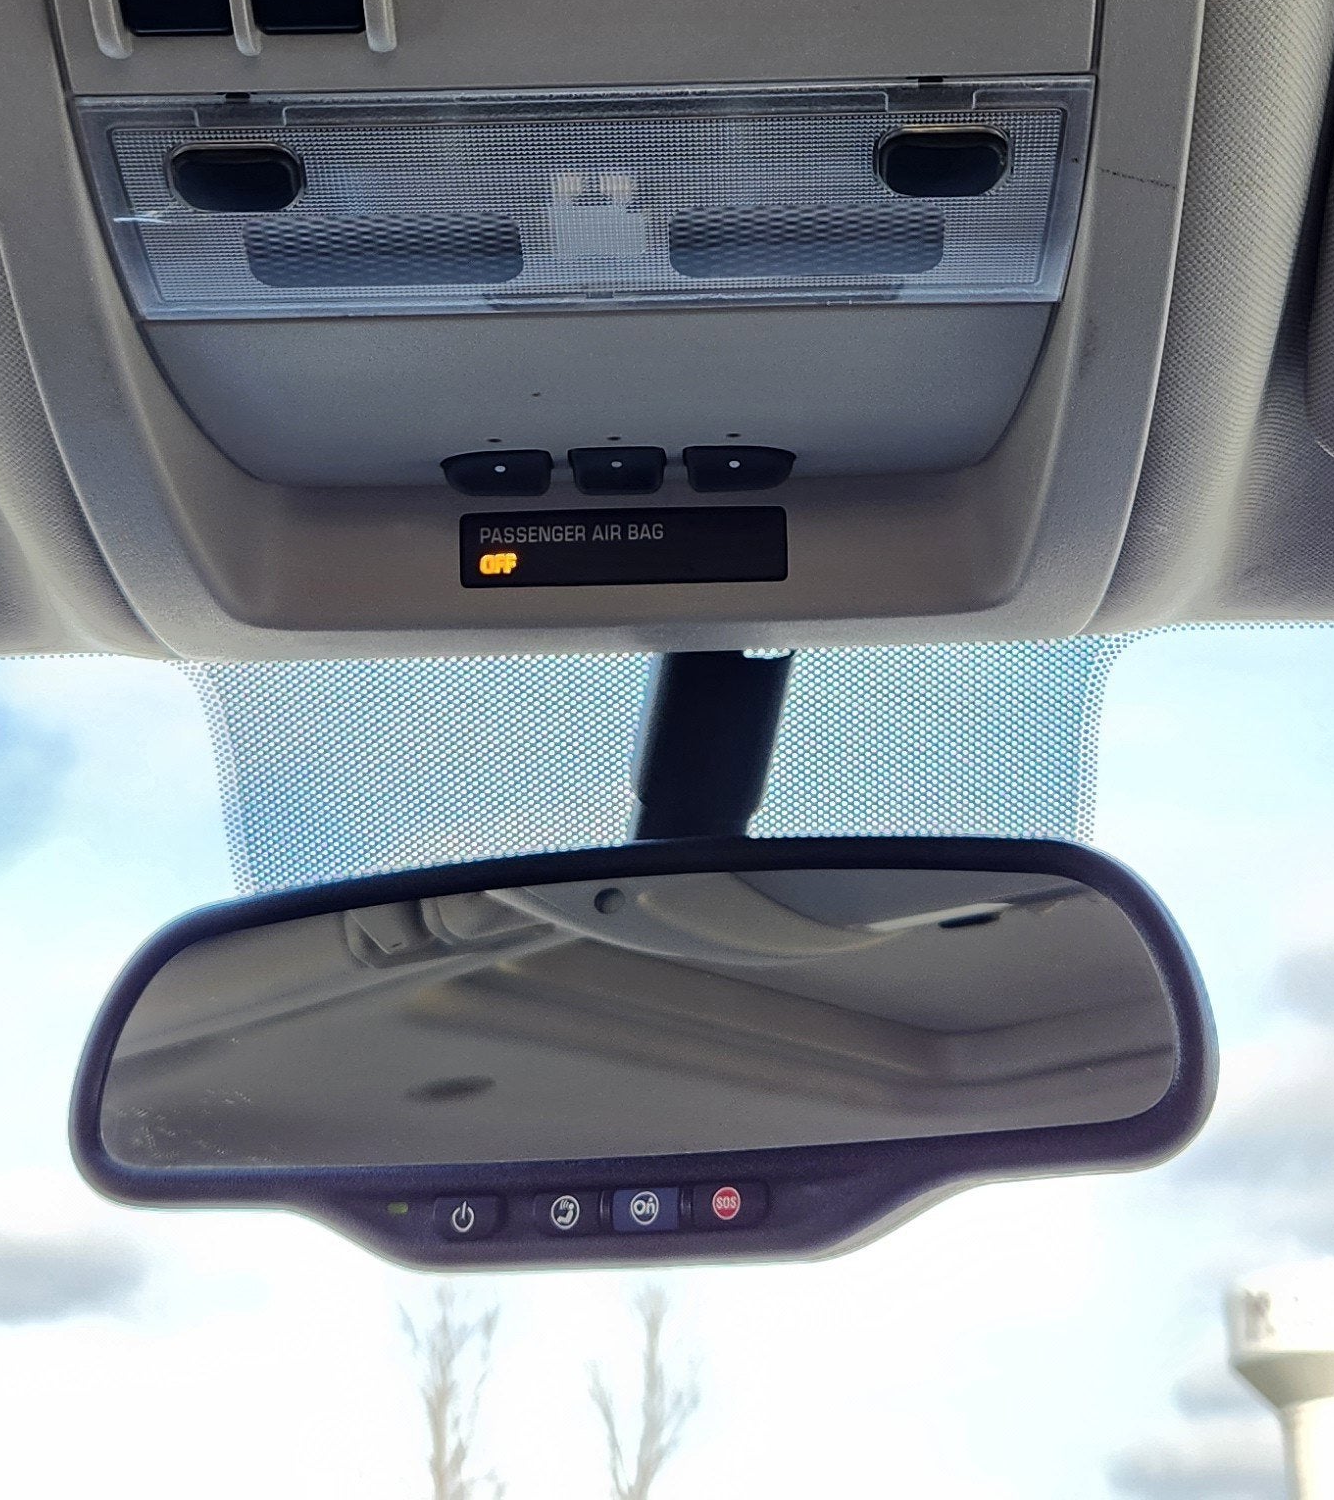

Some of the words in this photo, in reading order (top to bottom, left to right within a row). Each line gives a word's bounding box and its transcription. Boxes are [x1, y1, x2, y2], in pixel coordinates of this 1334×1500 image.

[480, 524, 586, 543] PASSENGER
[592, 523, 622, 541] AIR
[627, 522, 664, 540] BAG
[479, 552, 517, 576] OFF
[716, 1196, 737, 1210] SOS
